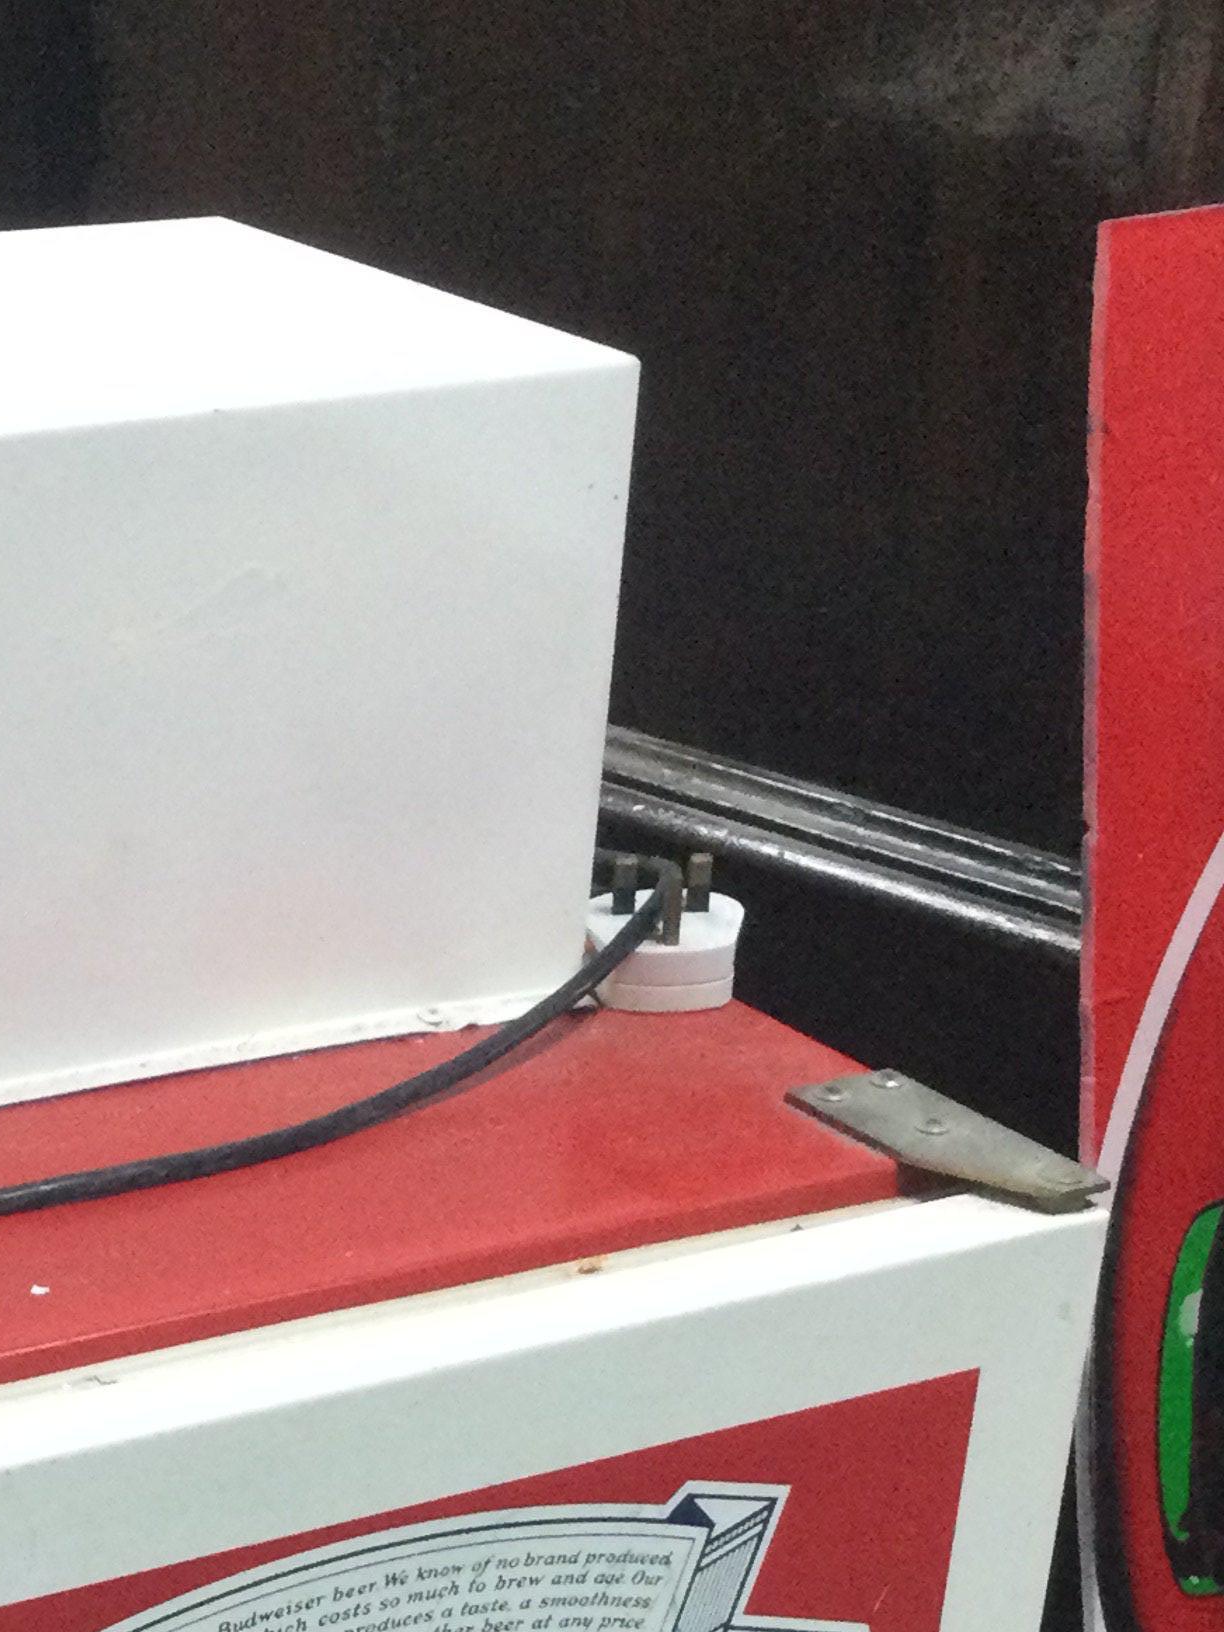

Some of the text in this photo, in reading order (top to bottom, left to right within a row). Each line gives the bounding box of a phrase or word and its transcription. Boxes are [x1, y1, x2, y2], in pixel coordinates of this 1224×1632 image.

[384, 1568, 409, 1588] We
[417, 1563, 464, 1582] know
[471, 1555, 493, 1577] of
[496, 1557, 519, 1570] no
[524, 1550, 581, 1567] brand
[583, 1549, 673, 1568] produced
[318, 1602, 372, 1628] costs
[378, 1596, 401, 1612] so
[406, 1580, 460, 1605] much
[467, 1578, 486, 1594] to
[494, 1574, 546, 1591] brew
[551, 1570, 590, 1586] and
[631, 1570, 664, 1586] Our
[441, 1606, 453, 1619] a
[519, 1598, 531, 1611] a
[538, 1591, 652, 1610] smoothness
[531, 1614, 553, 1630] at
[558, 1615, 593, 1631] any
